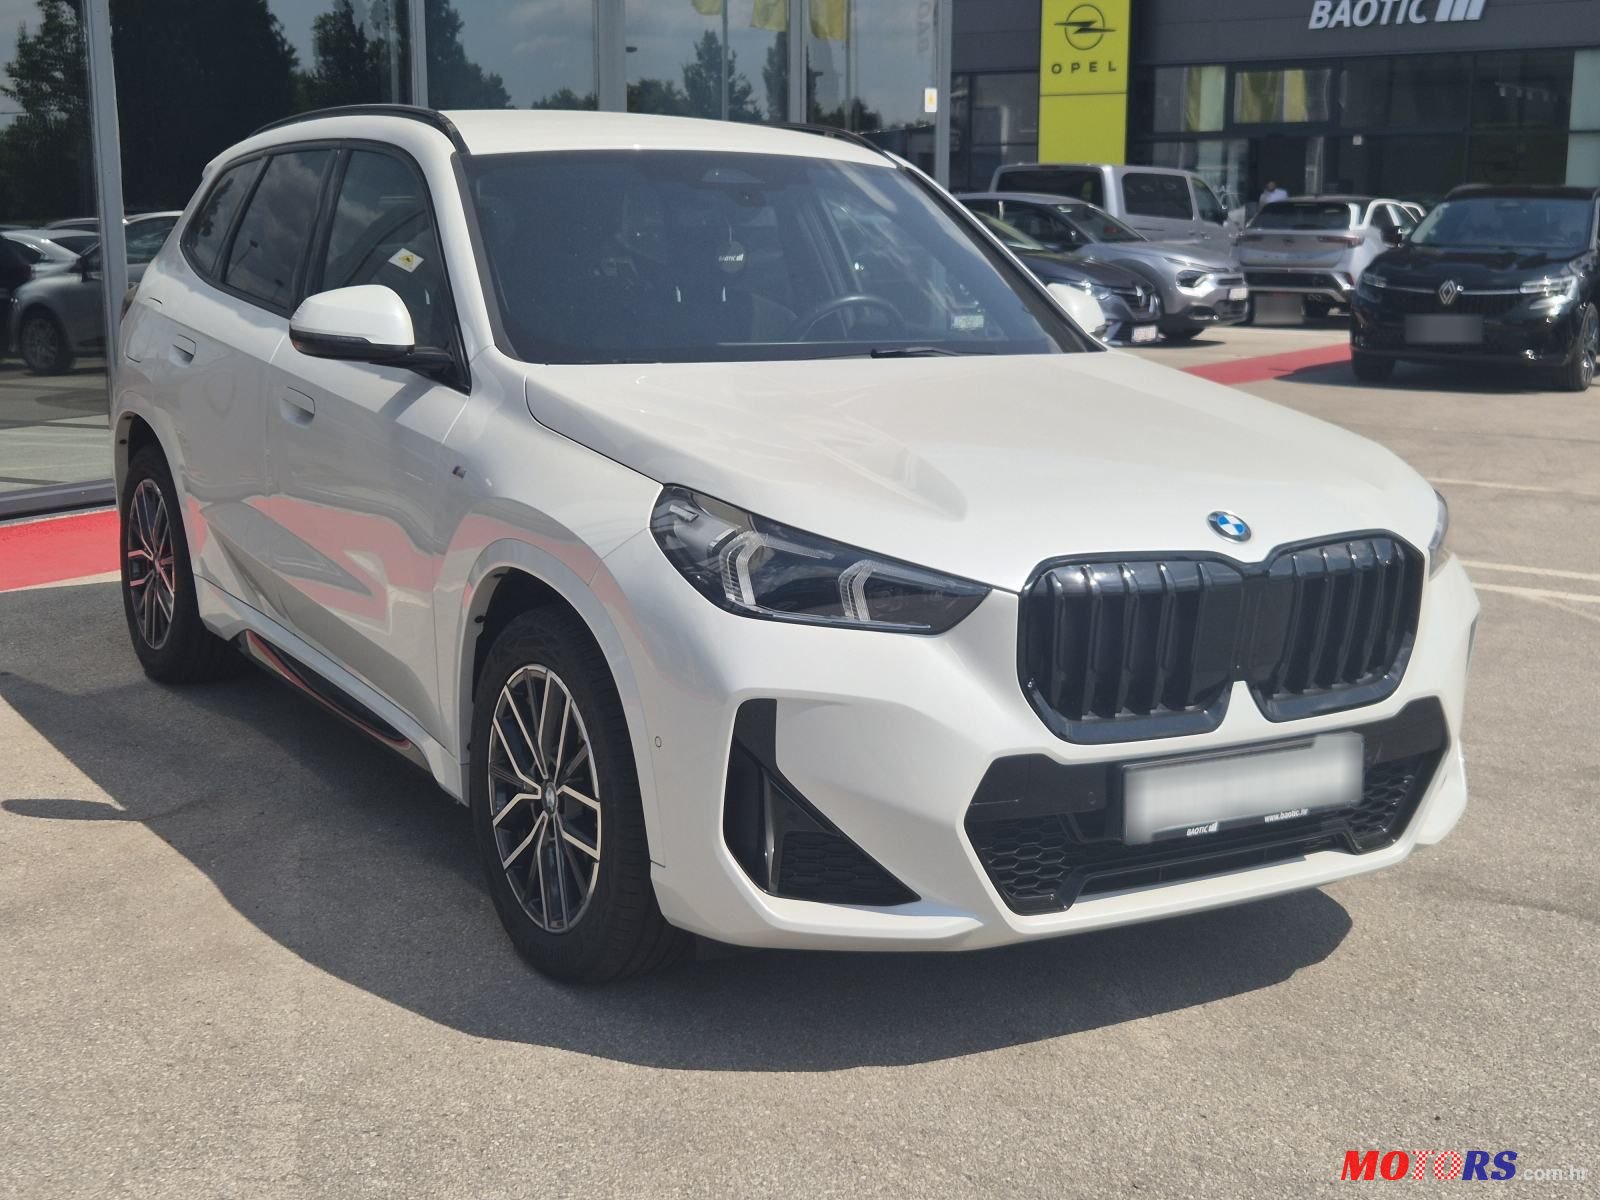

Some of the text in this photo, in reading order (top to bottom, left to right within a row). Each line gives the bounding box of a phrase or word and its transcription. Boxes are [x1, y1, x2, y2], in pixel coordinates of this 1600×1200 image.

[1308, 0, 1428, 30] BAOTIC
[1051, 61, 1117, 75] OPEL
[1186, 824, 1208, 836] BAOTIC
